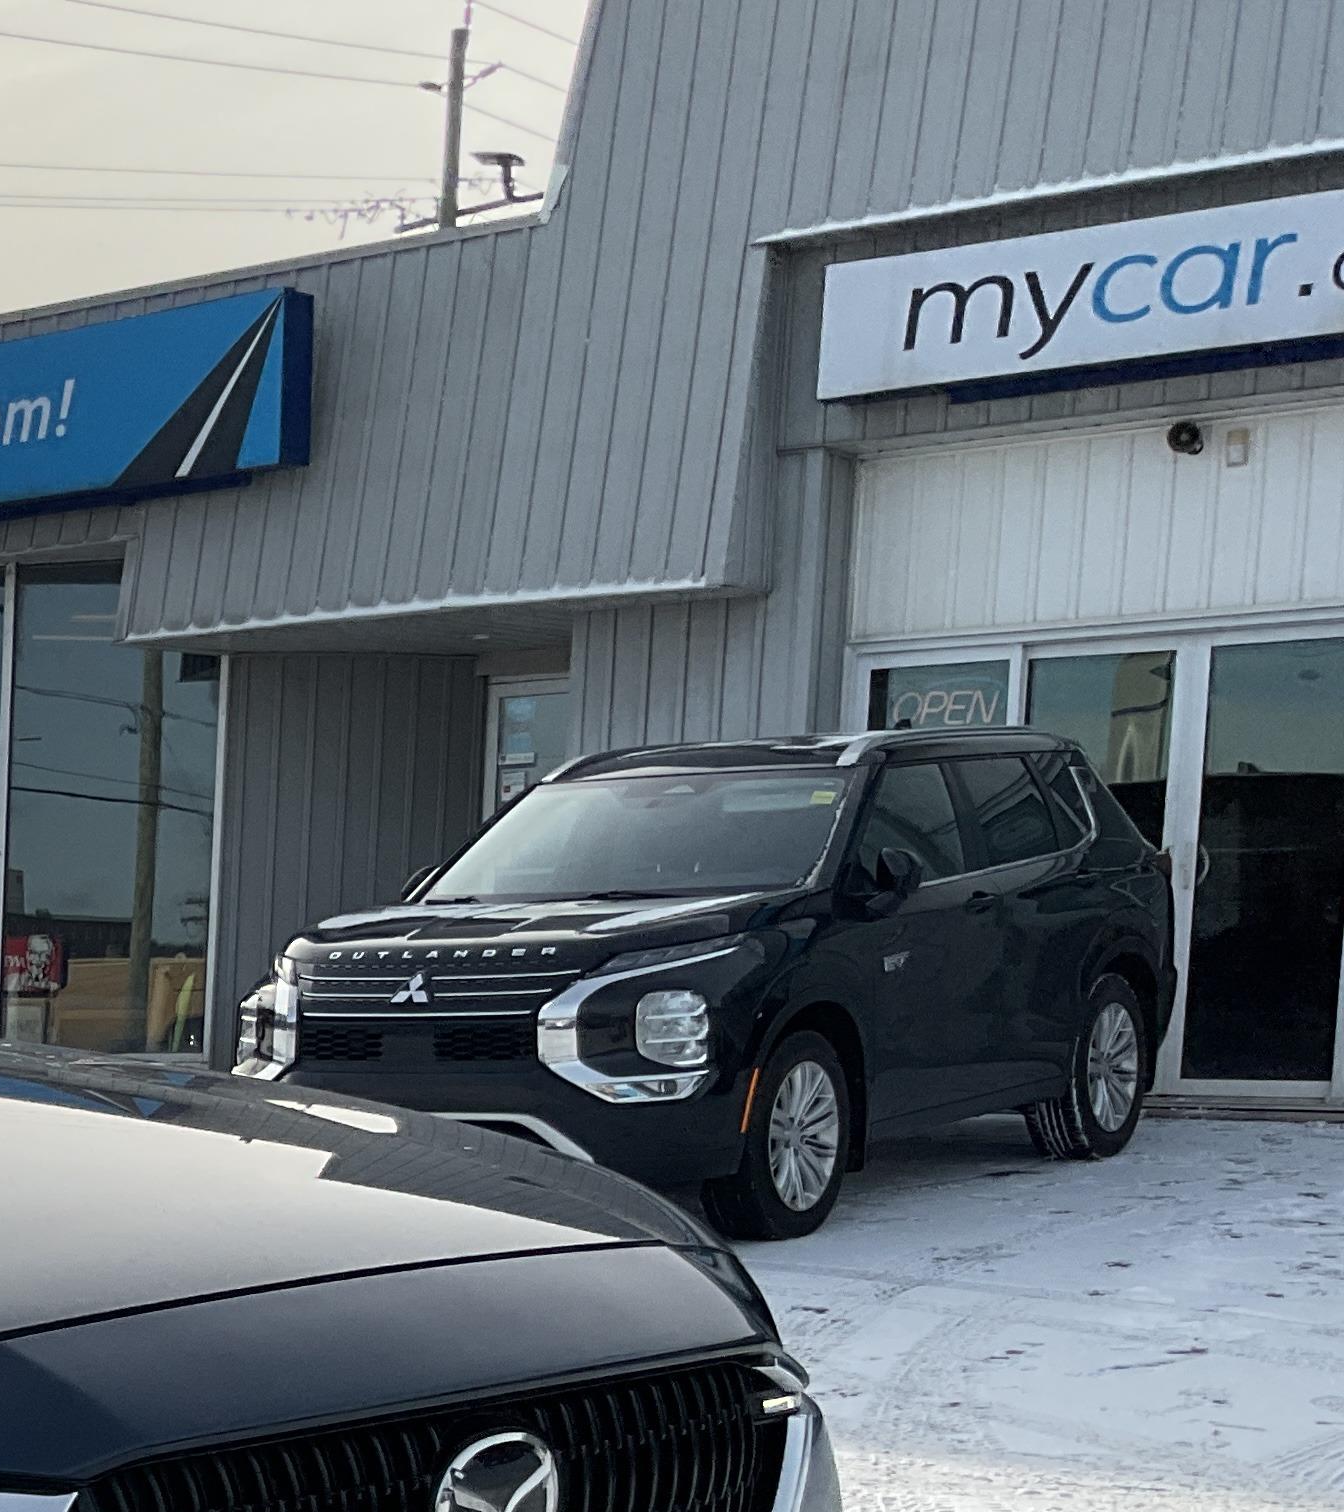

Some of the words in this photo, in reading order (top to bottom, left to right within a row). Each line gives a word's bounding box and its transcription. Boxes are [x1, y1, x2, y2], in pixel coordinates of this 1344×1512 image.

[903, 232, 1344, 360] mycar.
[891, 689, 1000, 727] OPEN
[328, 946, 556, 960] OUTLANDER
